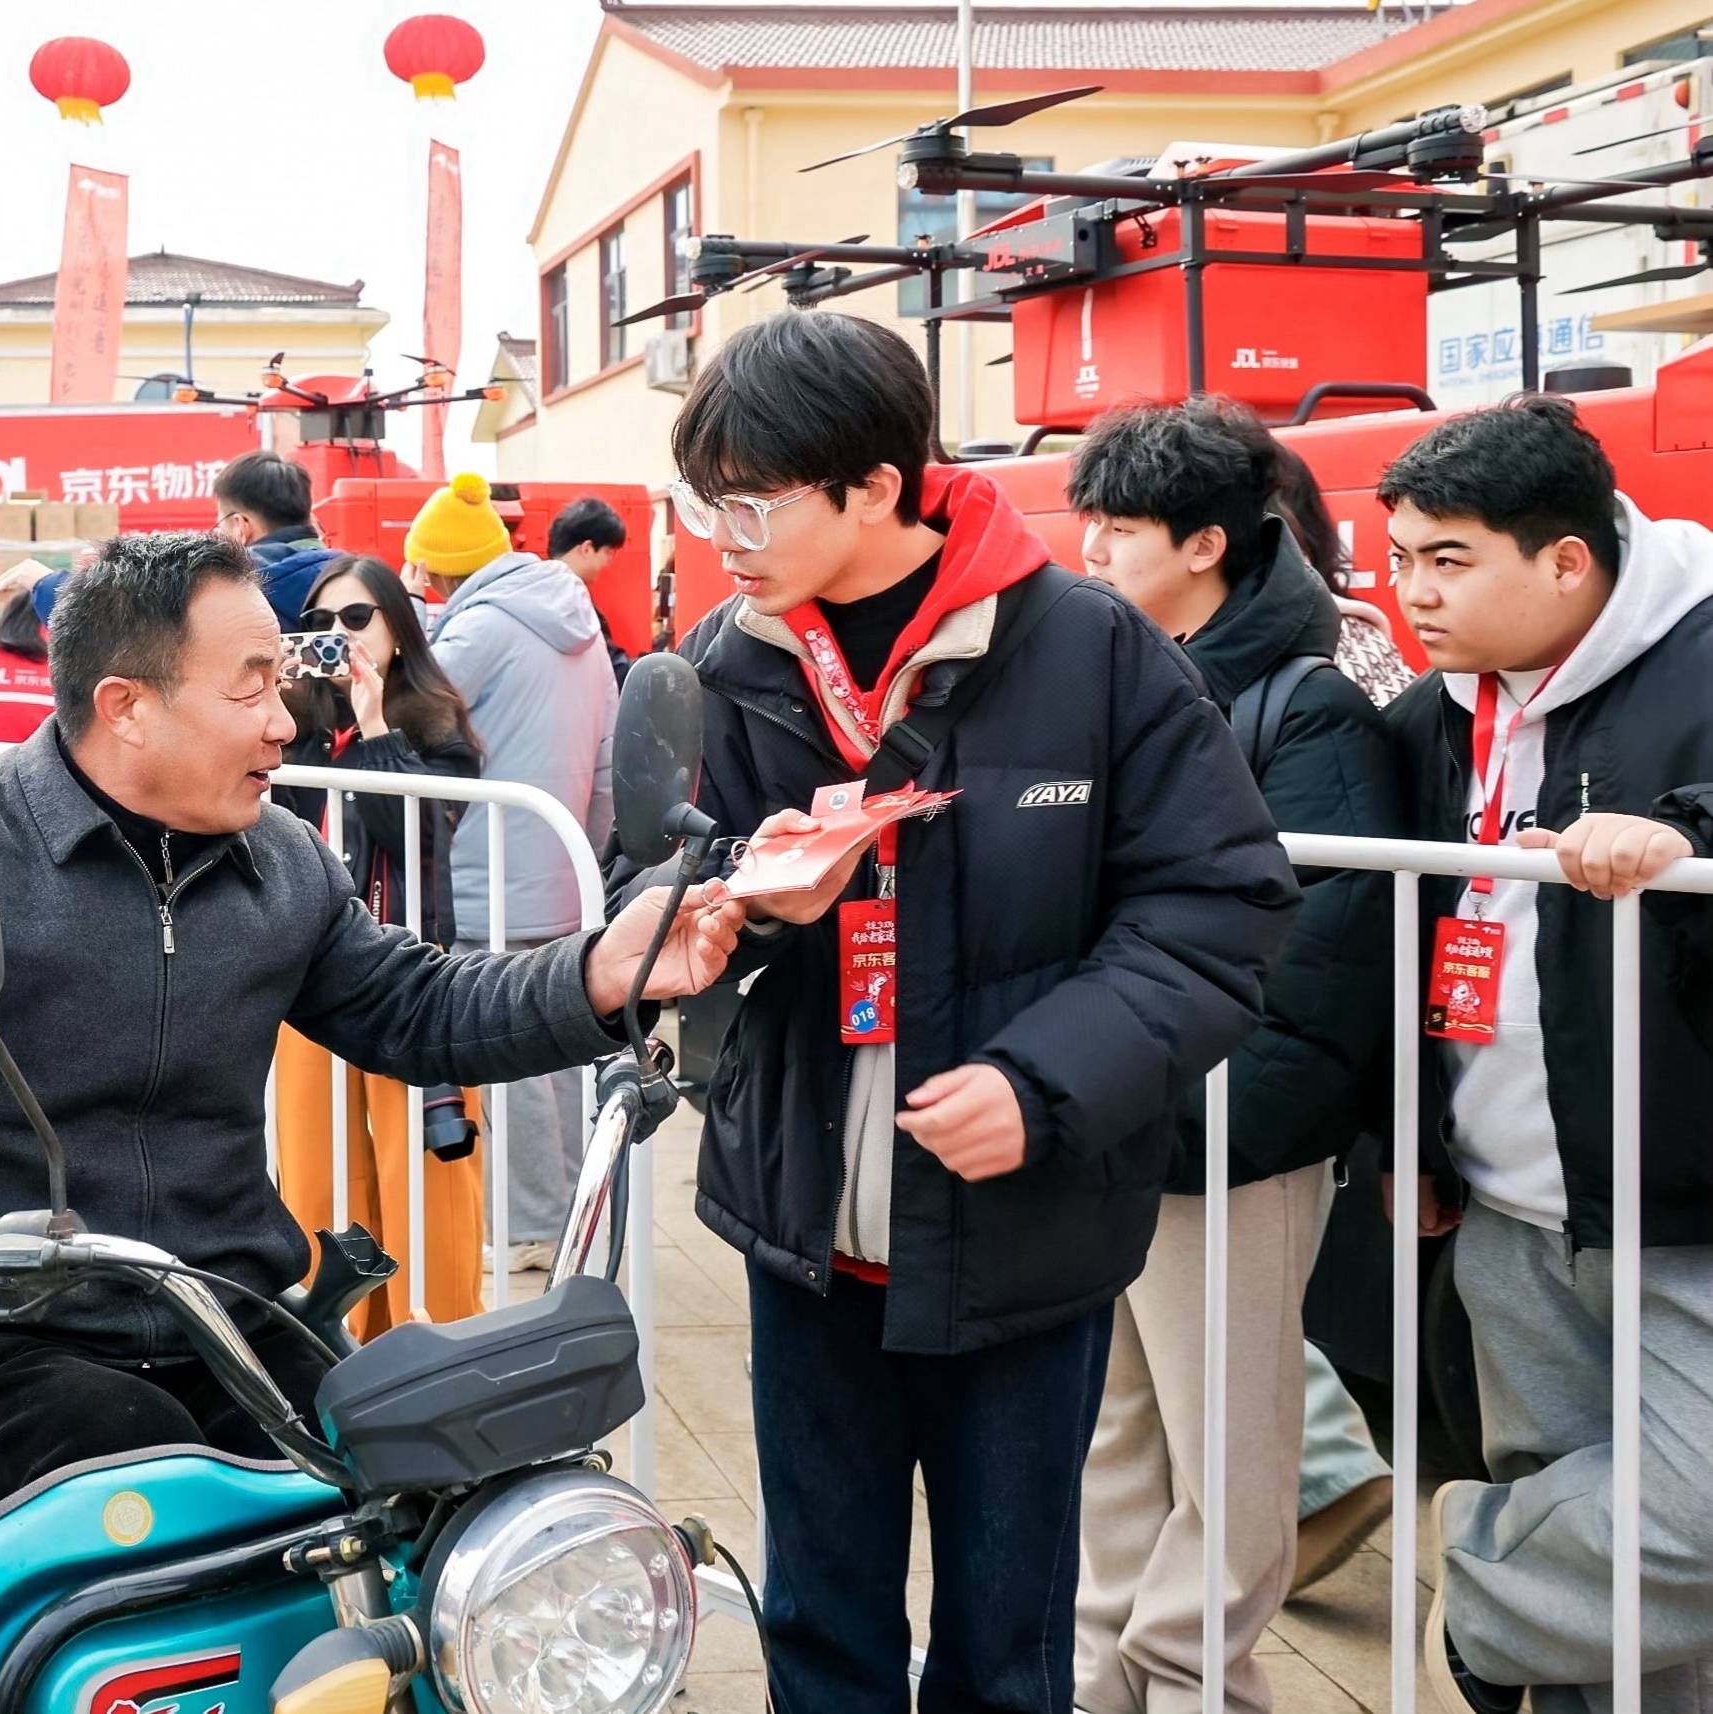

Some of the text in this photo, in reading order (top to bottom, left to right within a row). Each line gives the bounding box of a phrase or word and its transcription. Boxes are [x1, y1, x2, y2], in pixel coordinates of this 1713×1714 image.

[1439, 313, 1604, 374] 国家应通信
[1023, 784, 1089, 805] YAYA
[851, 1007, 876, 1026] 018
